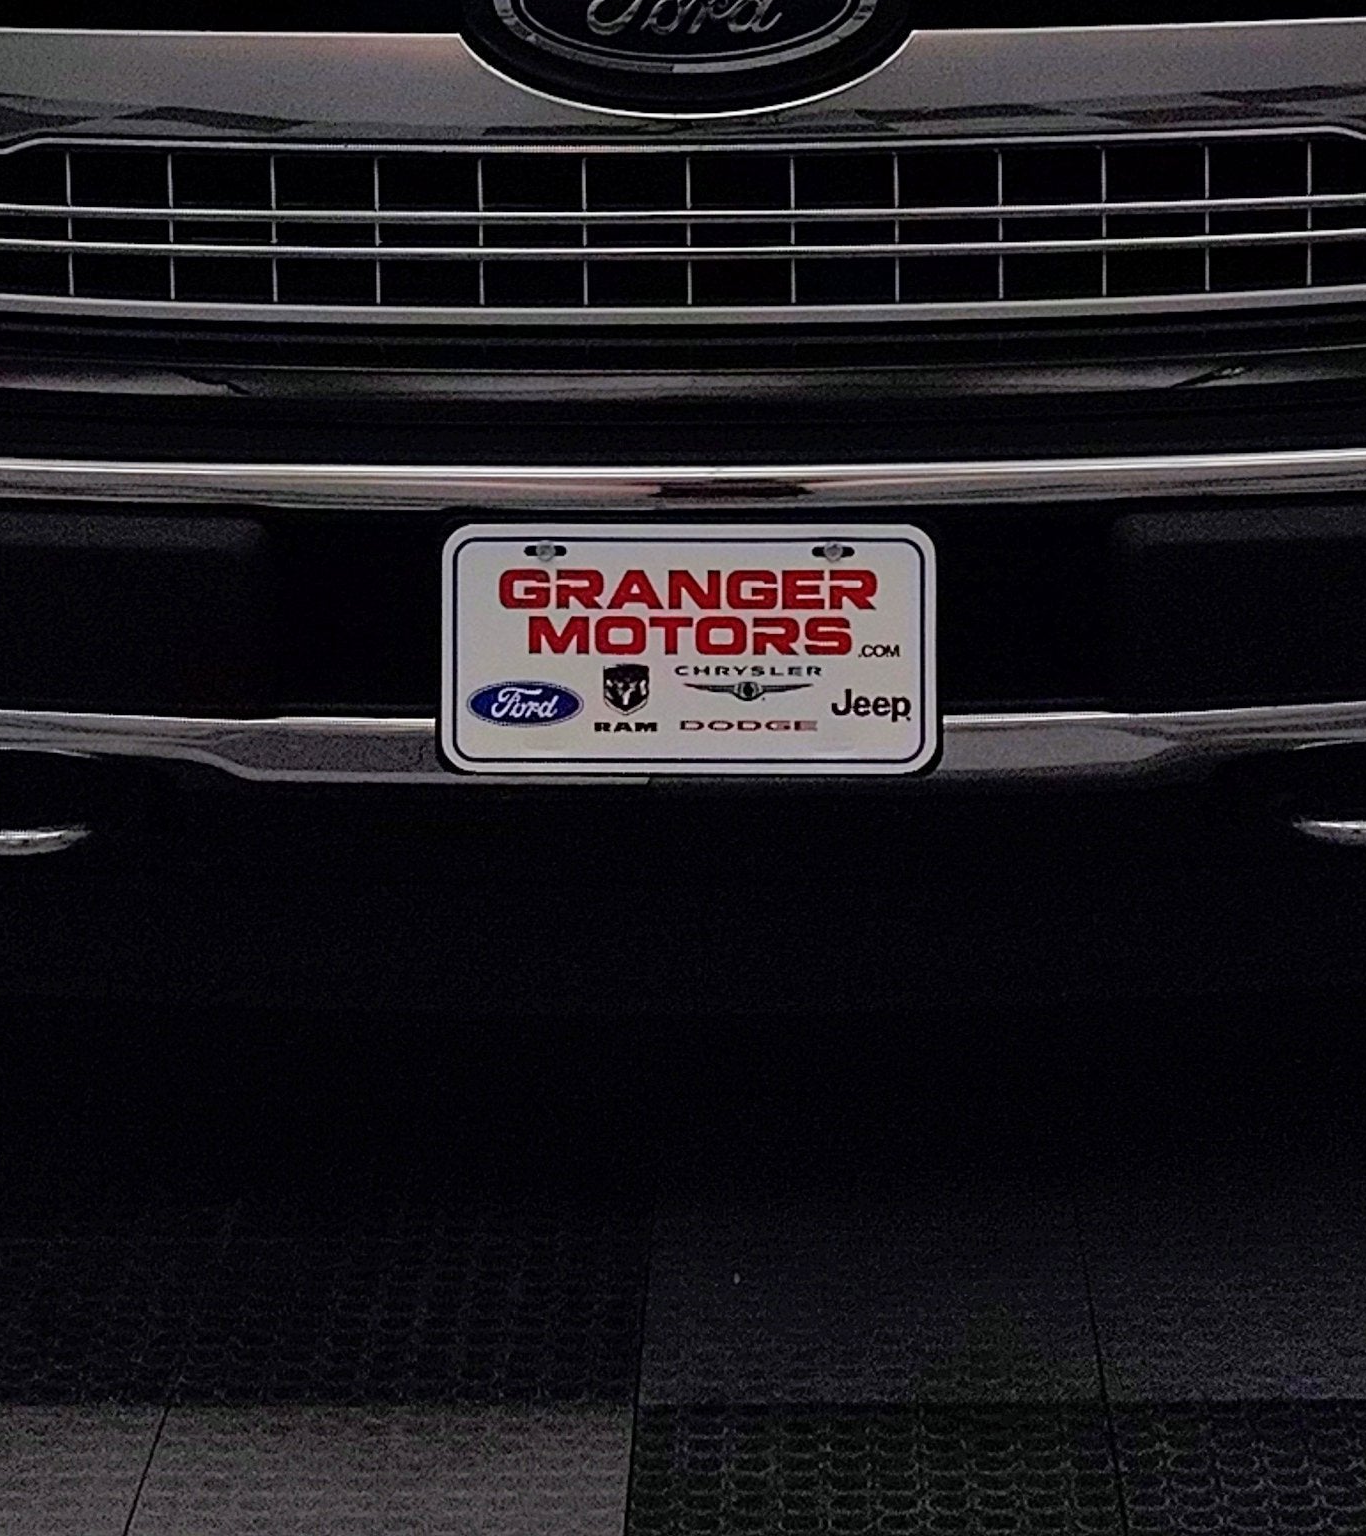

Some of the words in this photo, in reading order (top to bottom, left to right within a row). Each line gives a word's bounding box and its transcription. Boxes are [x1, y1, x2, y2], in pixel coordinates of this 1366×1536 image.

[499, 569, 878, 610] GRANGER
[528, 616, 853, 655] MOTORS
[675, 666, 823, 677] CHRYSLER
[491, 688, 560, 719] Ford
[831, 689, 911, 722] Jeep
[594, 721, 659, 733] RAM
[680, 720, 819, 732] DODGE
